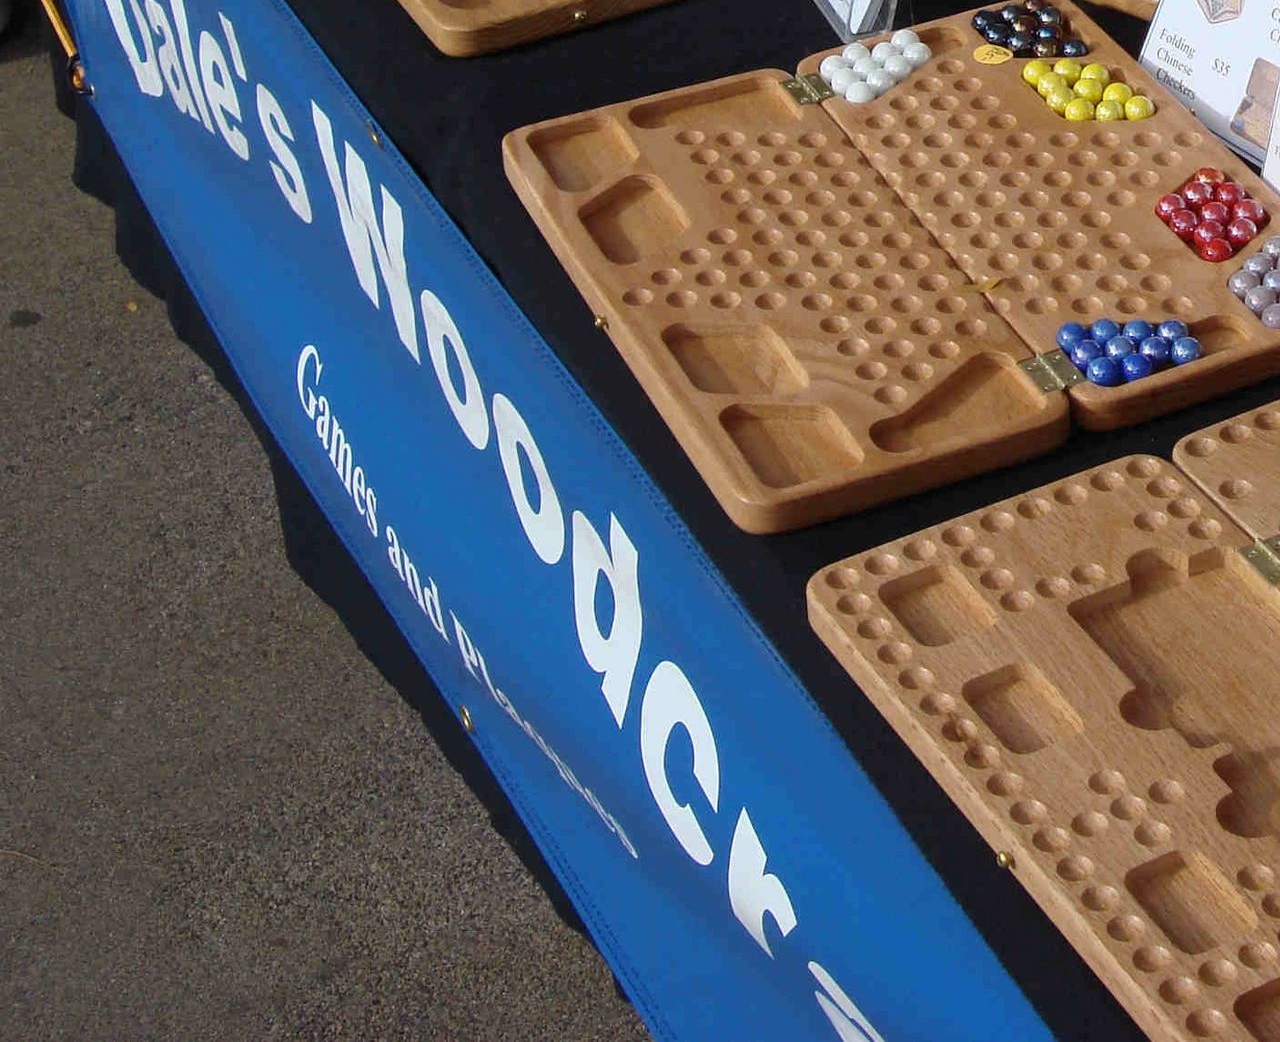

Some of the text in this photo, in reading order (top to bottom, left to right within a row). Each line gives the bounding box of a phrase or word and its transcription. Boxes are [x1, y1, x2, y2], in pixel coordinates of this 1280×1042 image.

[1159, 28, 1196, 58] Folding
[1156, 47, 1194, 76] Chinese
[1155, 68, 1196, 100] Checkers
[296, 344, 450, 644] Games and
